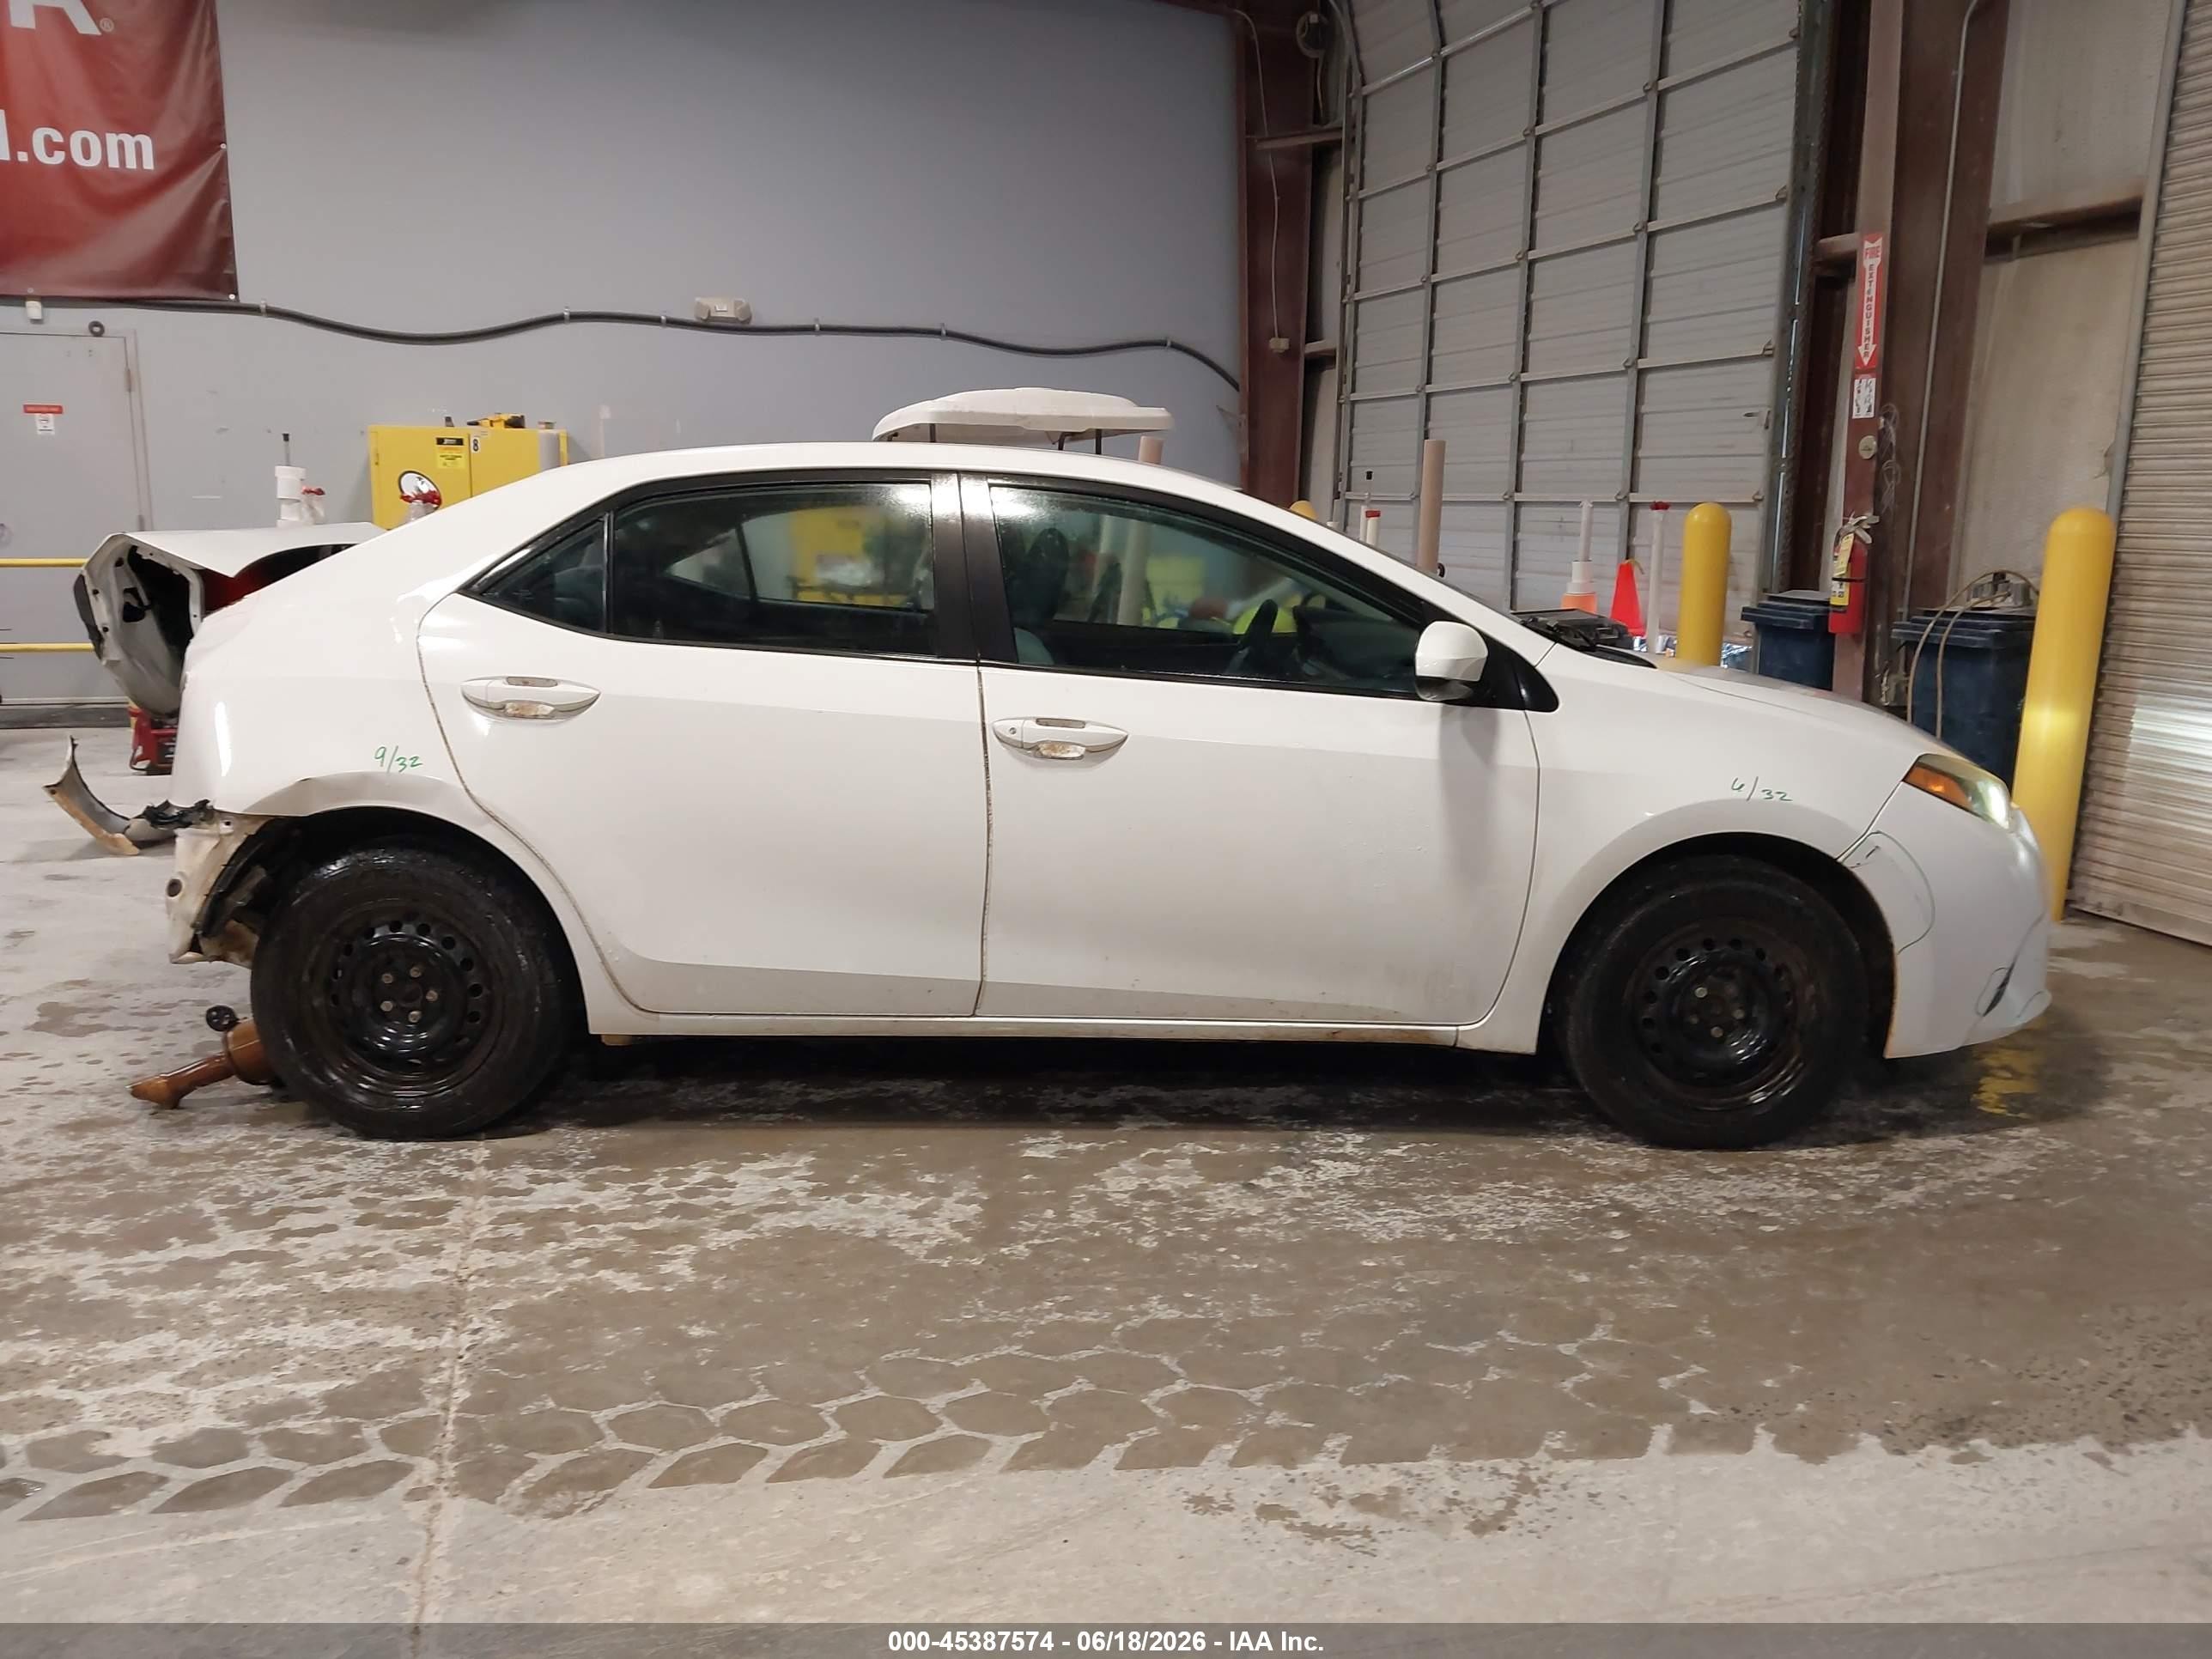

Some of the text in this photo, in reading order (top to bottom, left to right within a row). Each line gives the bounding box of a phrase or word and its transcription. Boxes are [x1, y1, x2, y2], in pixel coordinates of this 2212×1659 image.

[1864, 246, 1881, 259] FIRE
[472, 438, 479, 452] 8
[374, 744, 423, 775] 9/32
